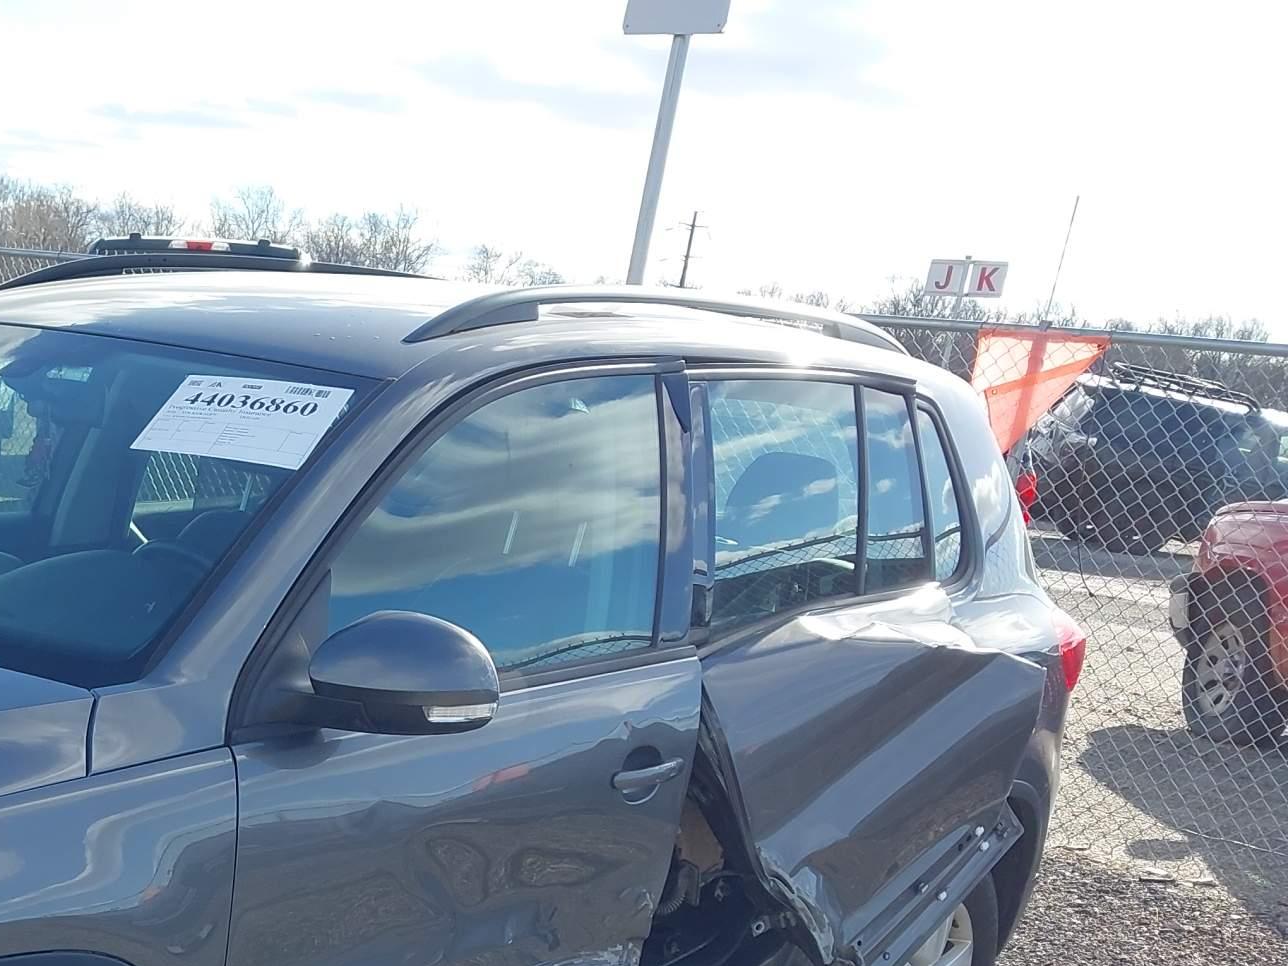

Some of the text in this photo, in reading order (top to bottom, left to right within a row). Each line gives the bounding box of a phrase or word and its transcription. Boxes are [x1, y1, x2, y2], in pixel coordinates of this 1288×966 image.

[934, 265, 954, 290] J
[976, 266, 1001, 292] K
[184, 391, 319, 417] 44036860
